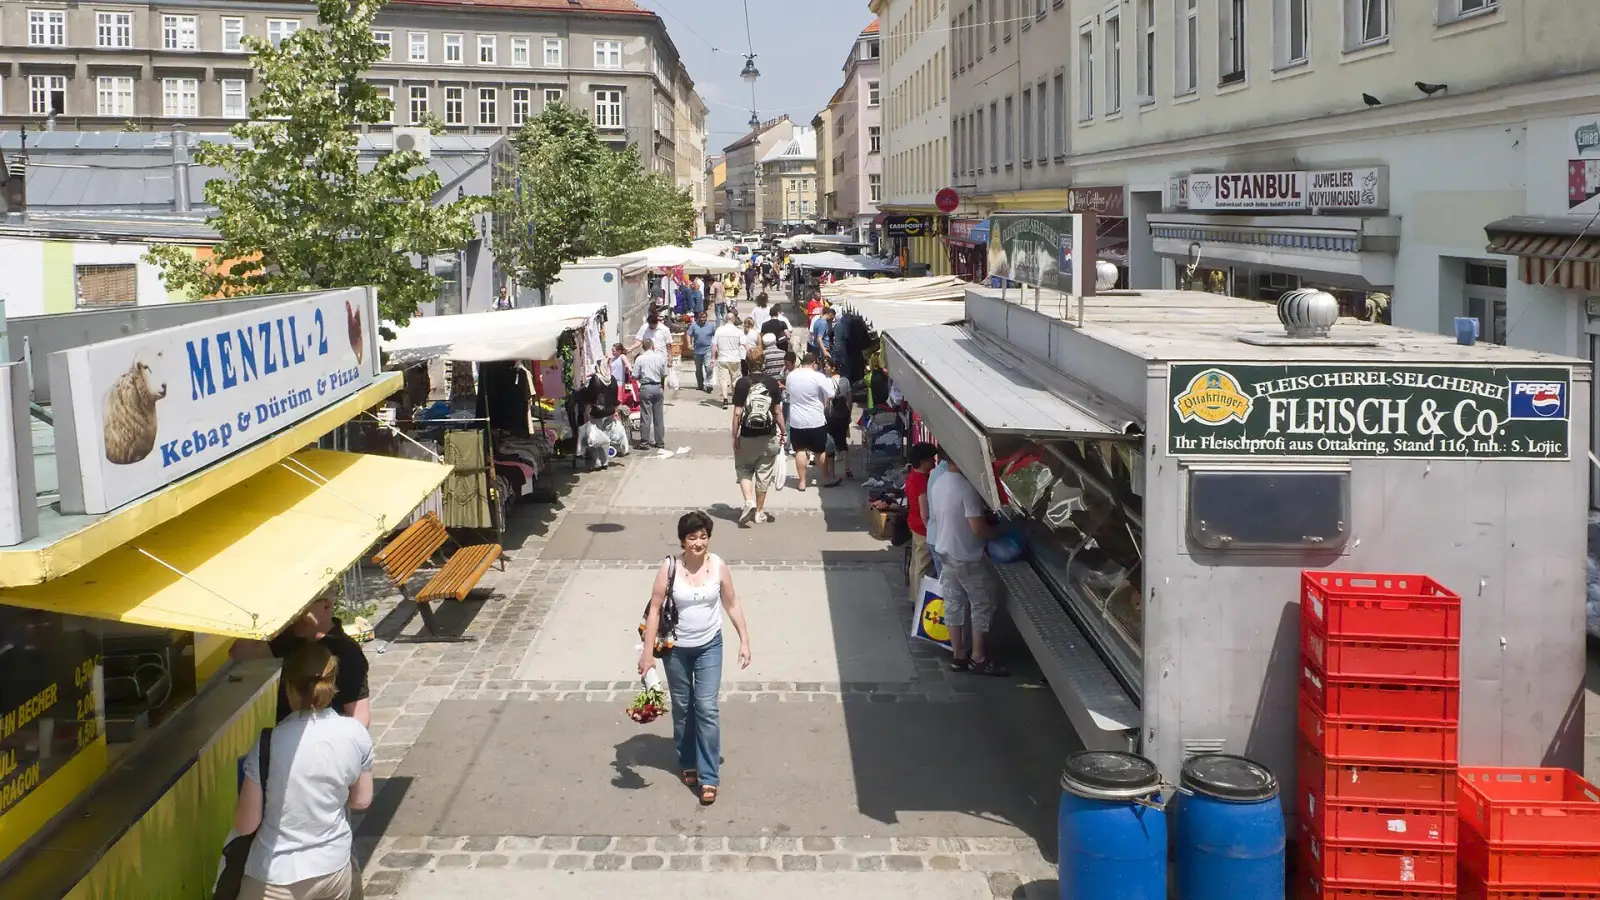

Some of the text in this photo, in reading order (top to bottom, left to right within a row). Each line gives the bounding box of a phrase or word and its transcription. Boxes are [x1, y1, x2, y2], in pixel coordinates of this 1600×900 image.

[1215, 173, 1301, 199] ISTANBUL
[1312, 171, 1354, 189] JUWELIER
[1308, 190, 1360, 208] KUYUMCUSU
[186, 307, 328, 401] MENZIL-2
[1254, 371, 1504, 401] FLEISCHEREI-SELCHEREI
[1514, 383, 1561, 395] PEPSI
[1184, 392, 1243, 409] Ottakringer
[160, 364, 360, 468] Kebap & Dürüm & Pizza
[1268, 398, 1506, 436] FLEISCH & Co.
[1174, 436, 1198, 450] Ihr
[1200, 434, 1286, 453] Fleischprofi
[1289, 439, 1314, 451] aus
[1317, 437, 1389, 454] Ottakring,
[1393, 438, 1434, 452] Stand
[1440, 439, 1469, 454] 116,
[1511, 439, 1524, 453] S.
[1527, 439, 1562, 457] Lojic
[5, 710, 16, 737] IN
[18, 683, 58, 728] BECHER
